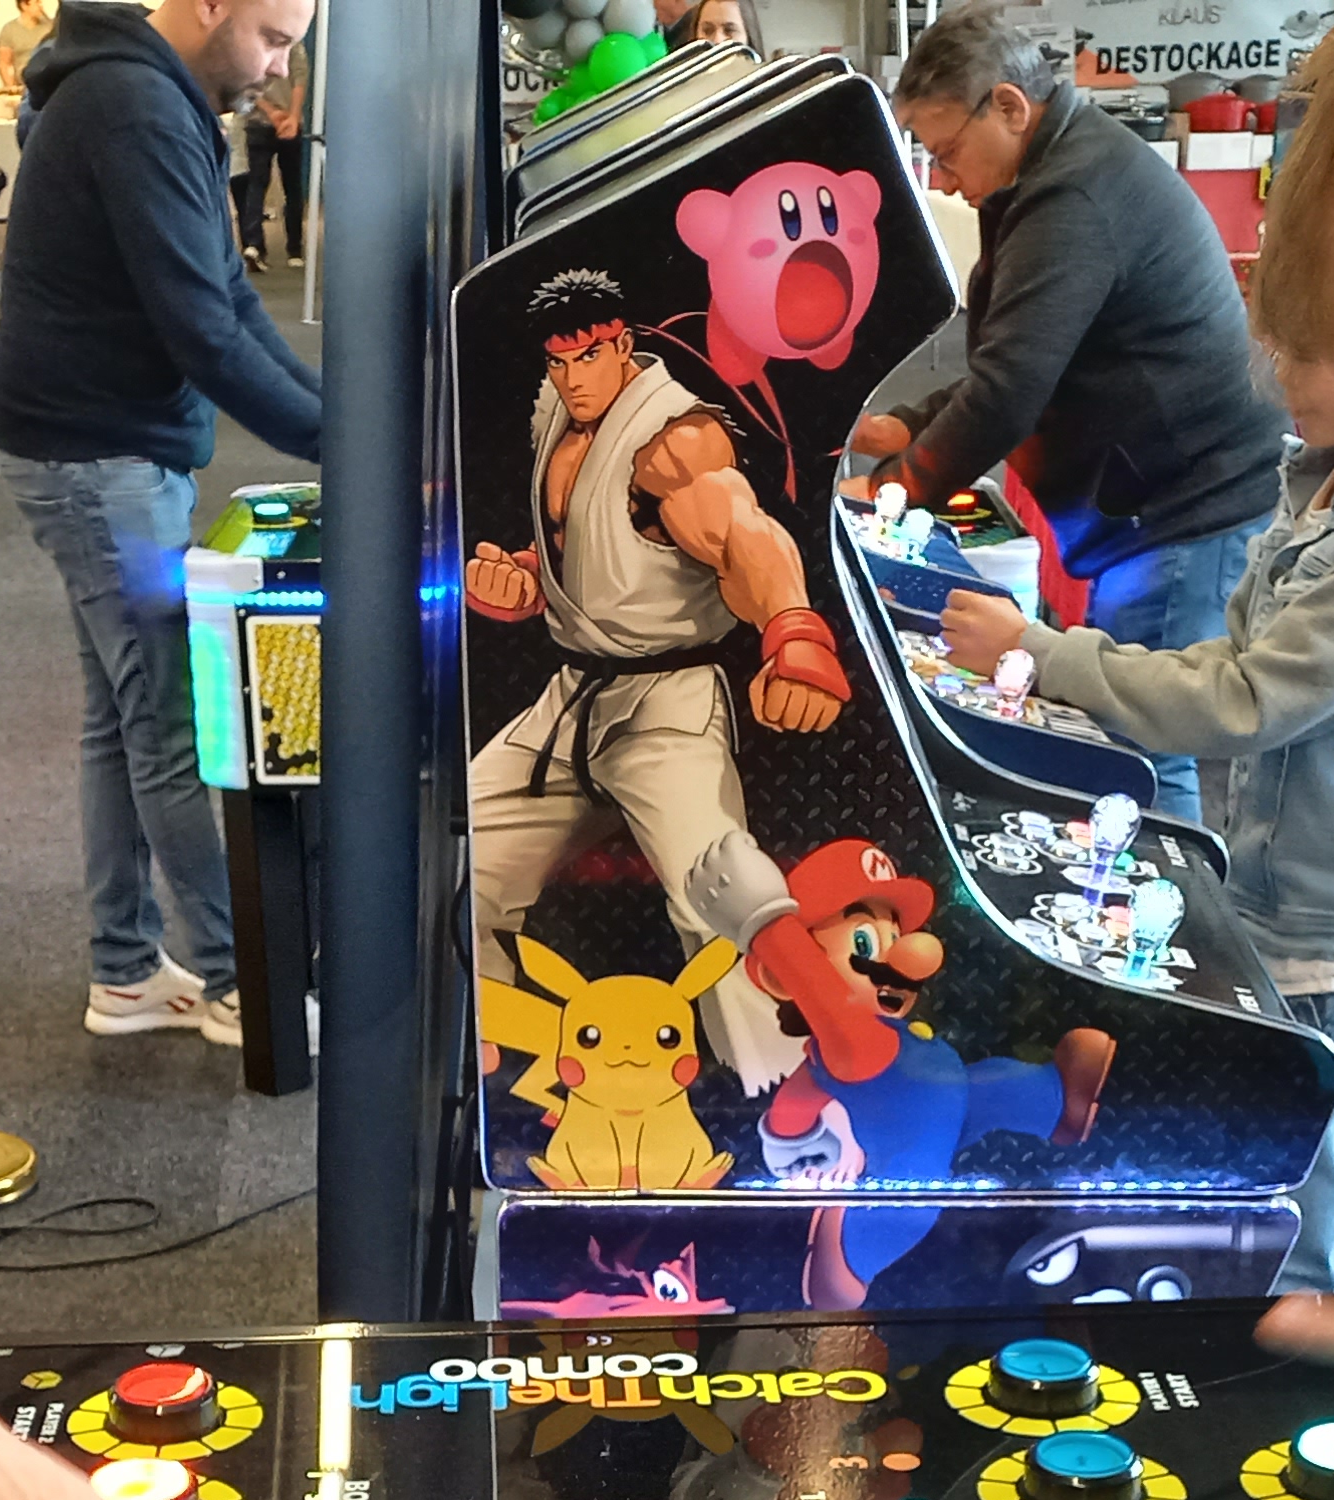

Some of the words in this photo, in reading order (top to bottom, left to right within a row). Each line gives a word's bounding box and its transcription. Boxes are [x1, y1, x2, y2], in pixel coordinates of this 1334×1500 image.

[1095, 38, 1282, 75] DESTOCKAGE
[430, 1353, 698, 1381] combo
[350, 1369, 887, 1415] CatchTheLigh
[1165, 1373, 1200, 1408] START
[828, 1457, 869, 1470] 3
